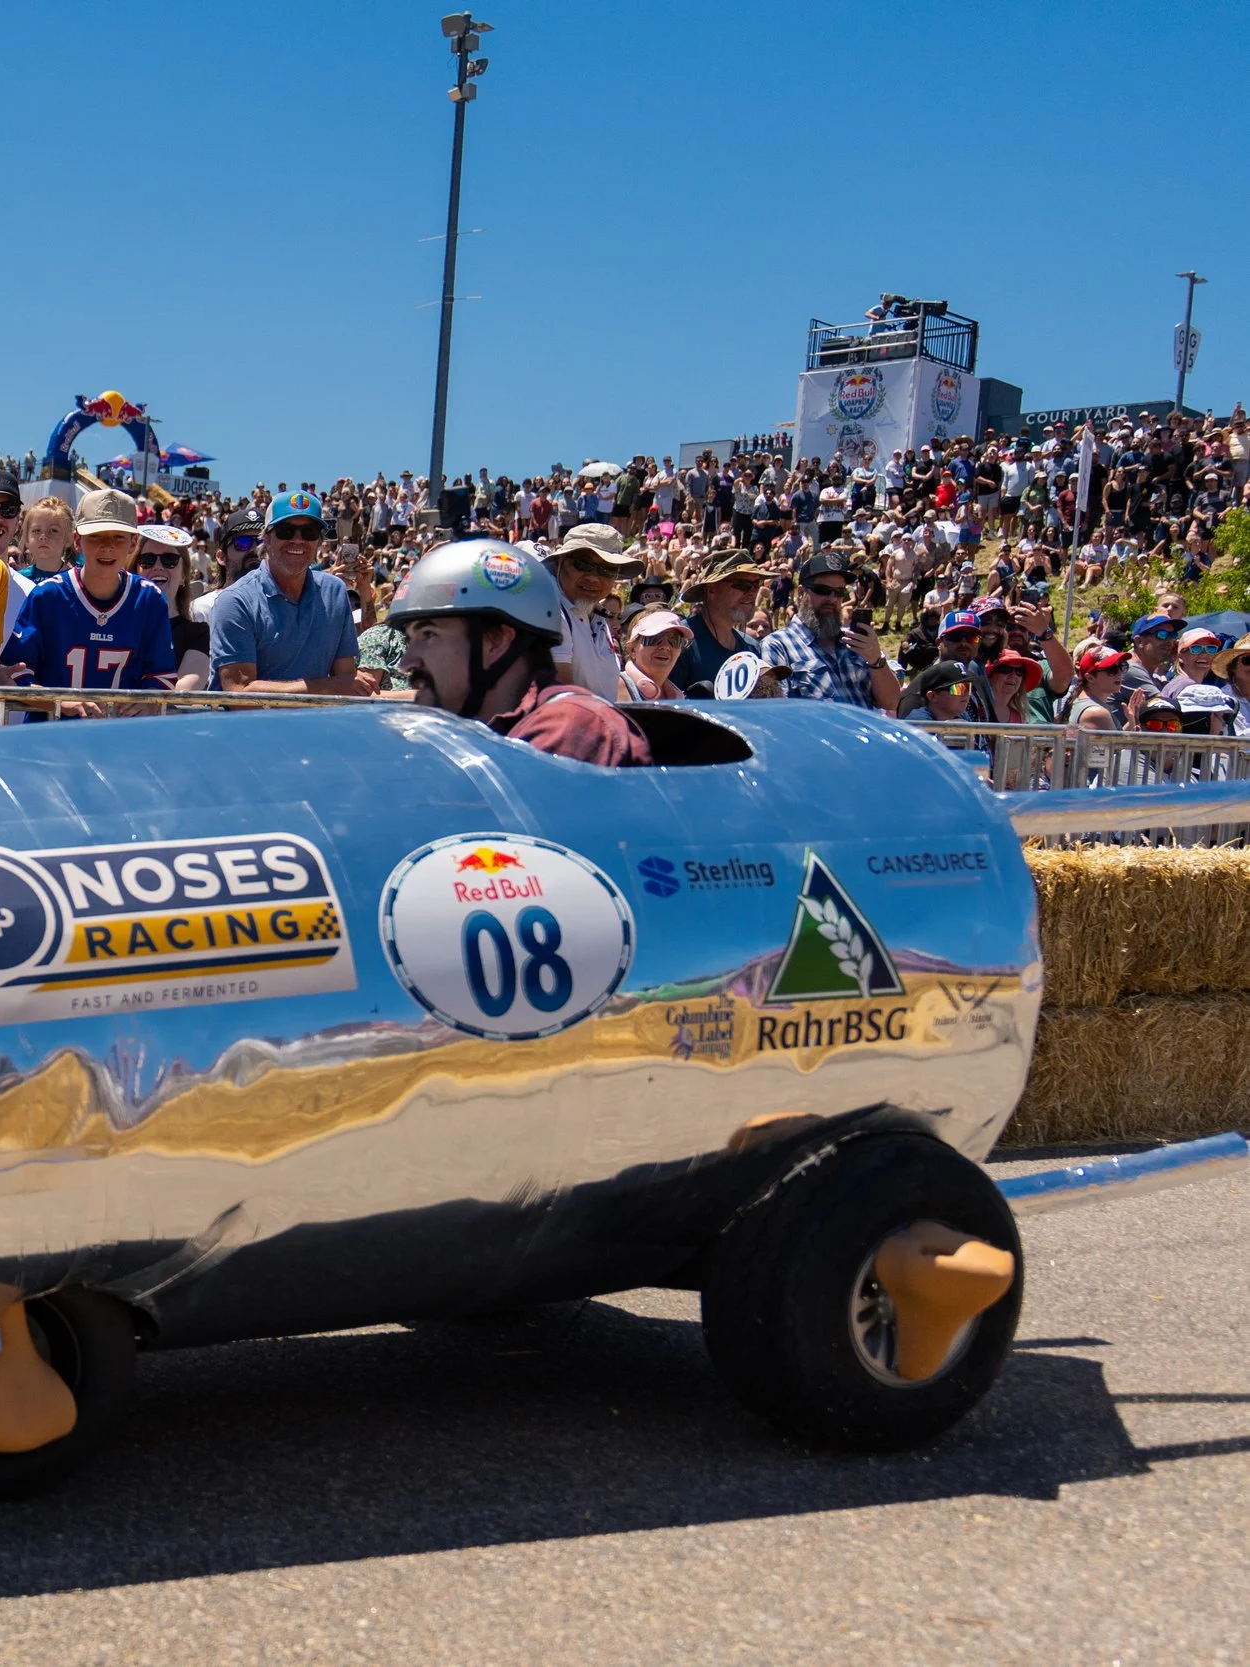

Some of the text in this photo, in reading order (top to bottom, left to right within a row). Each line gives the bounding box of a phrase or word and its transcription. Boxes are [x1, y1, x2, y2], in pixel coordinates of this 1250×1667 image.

[1179, 329, 1185, 345] G
[1190, 333, 1197, 349] G
[1188, 352, 1194, 368] 5
[1025, 406, 1128, 425] COURTYARD
[172, 479, 209, 494] JUDGES
[90, 632, 114, 641] BILLS
[66, 646, 132, 689] 17
[725, 663, 749, 697] 10
[60, 845, 310, 911] NOSES
[684, 856, 775, 887] Sterling
[84, 909, 300, 959] RACING
[460, 905, 573, 1018] 08
[71, 980, 260, 1010] FAST AND FERMENTED
[699, 1022, 734, 1041] Label
[758, 1007, 908, 1051] RahrBSG
